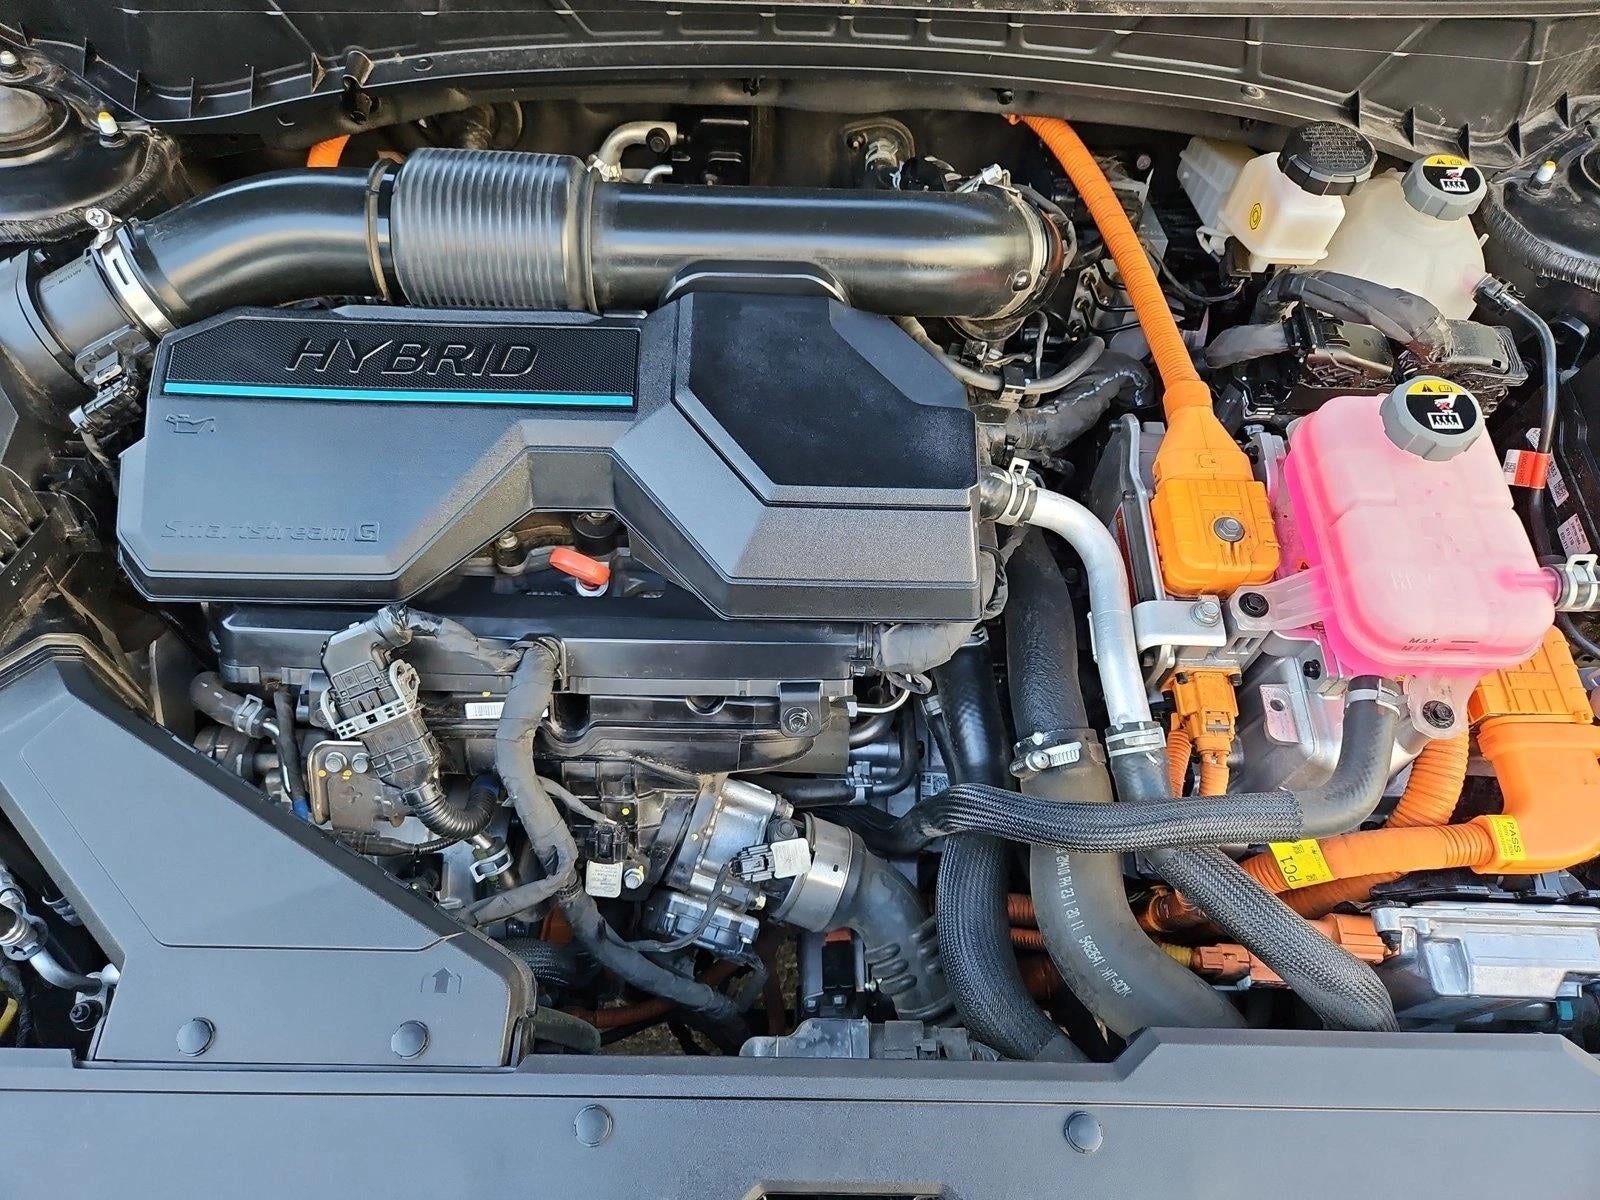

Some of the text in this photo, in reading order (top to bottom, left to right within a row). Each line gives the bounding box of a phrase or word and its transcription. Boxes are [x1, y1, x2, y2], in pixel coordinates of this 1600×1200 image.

[284, 336, 539, 378] HYBRID
[160, 519, 349, 542] Smartstream
[1506, 821, 1522, 853] PASS
[1282, 855, 1301, 883] PC1
